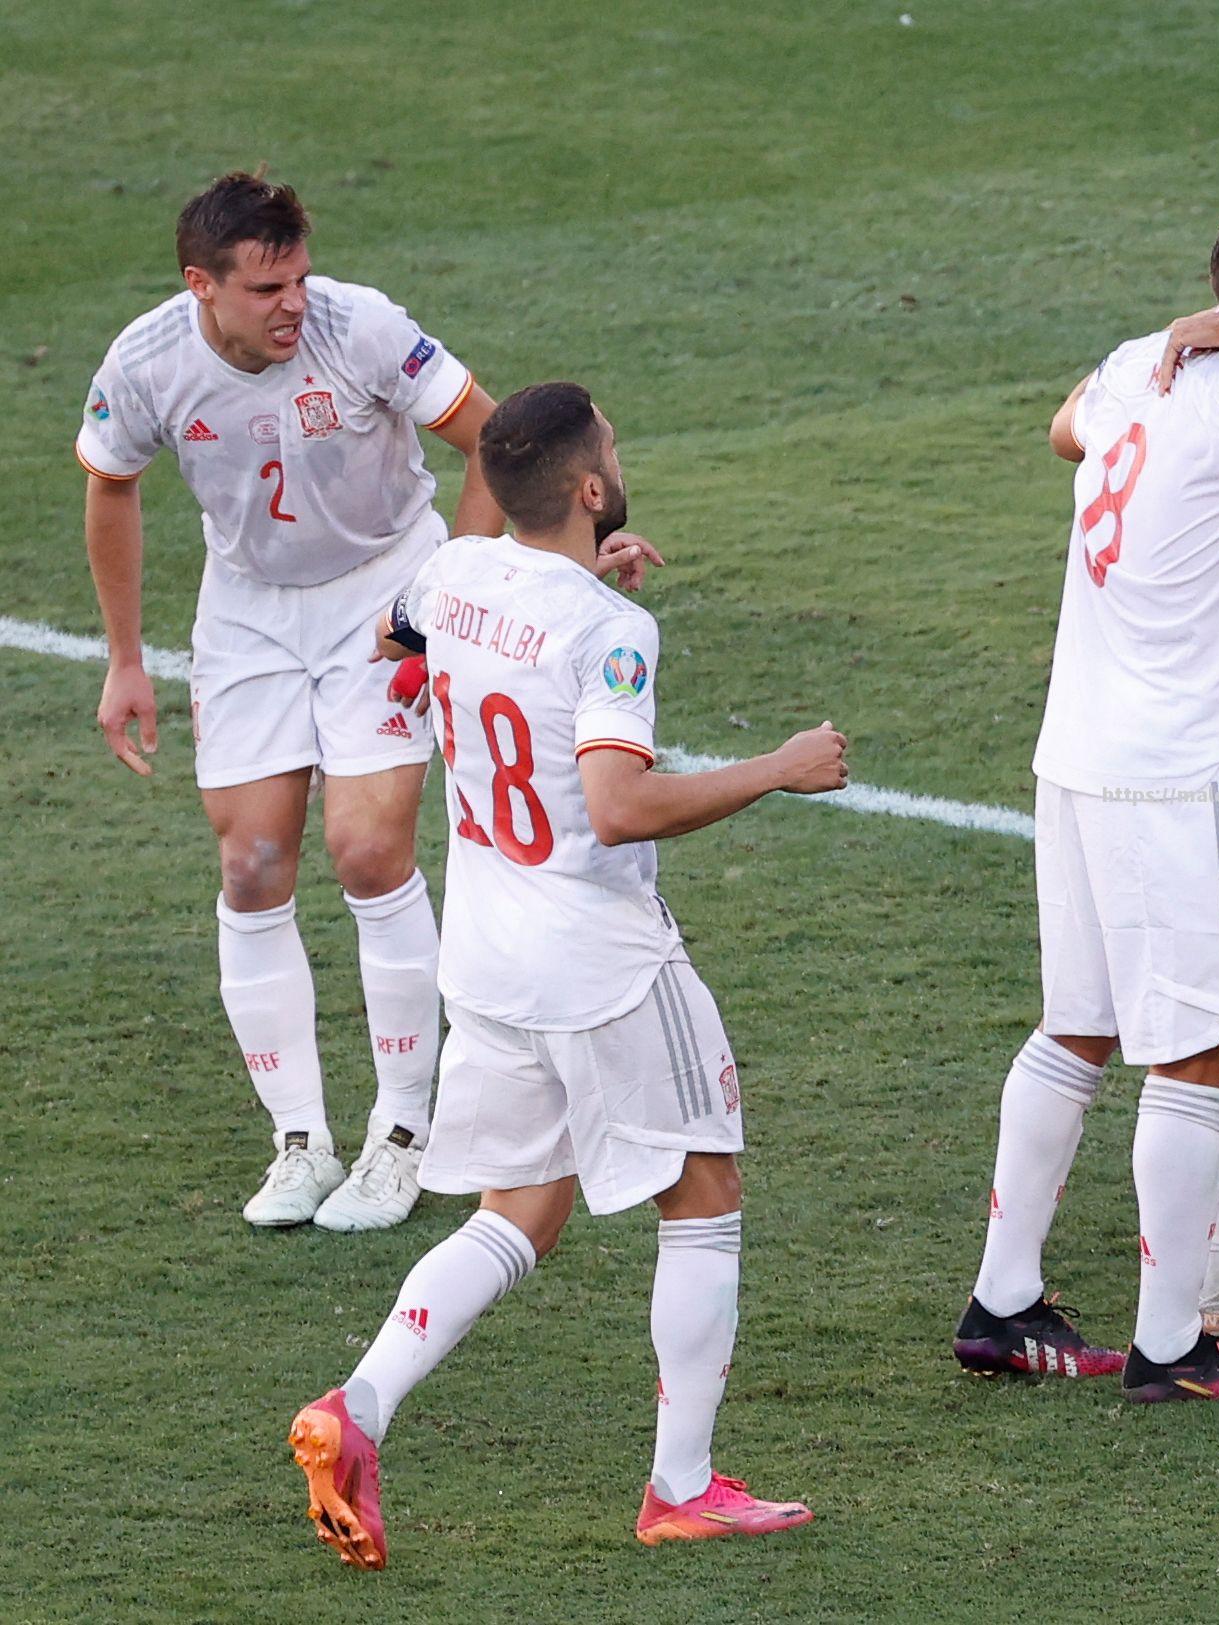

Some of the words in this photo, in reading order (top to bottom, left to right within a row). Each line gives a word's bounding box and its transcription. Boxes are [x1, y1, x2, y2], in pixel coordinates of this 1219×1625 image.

[183, 433, 219, 441] adidas
[260, 460, 297, 523] 2
[1080, 422, 1147, 588] 8
[487, 615, 547, 668] ALBA
[376, 727, 412, 739] adidas
[433, 670, 554, 867] 18
[376, 1034, 420, 1055] RFEF
[245, 1052, 280, 1072] RFEF
[391, 1313, 428, 1342] adidas
